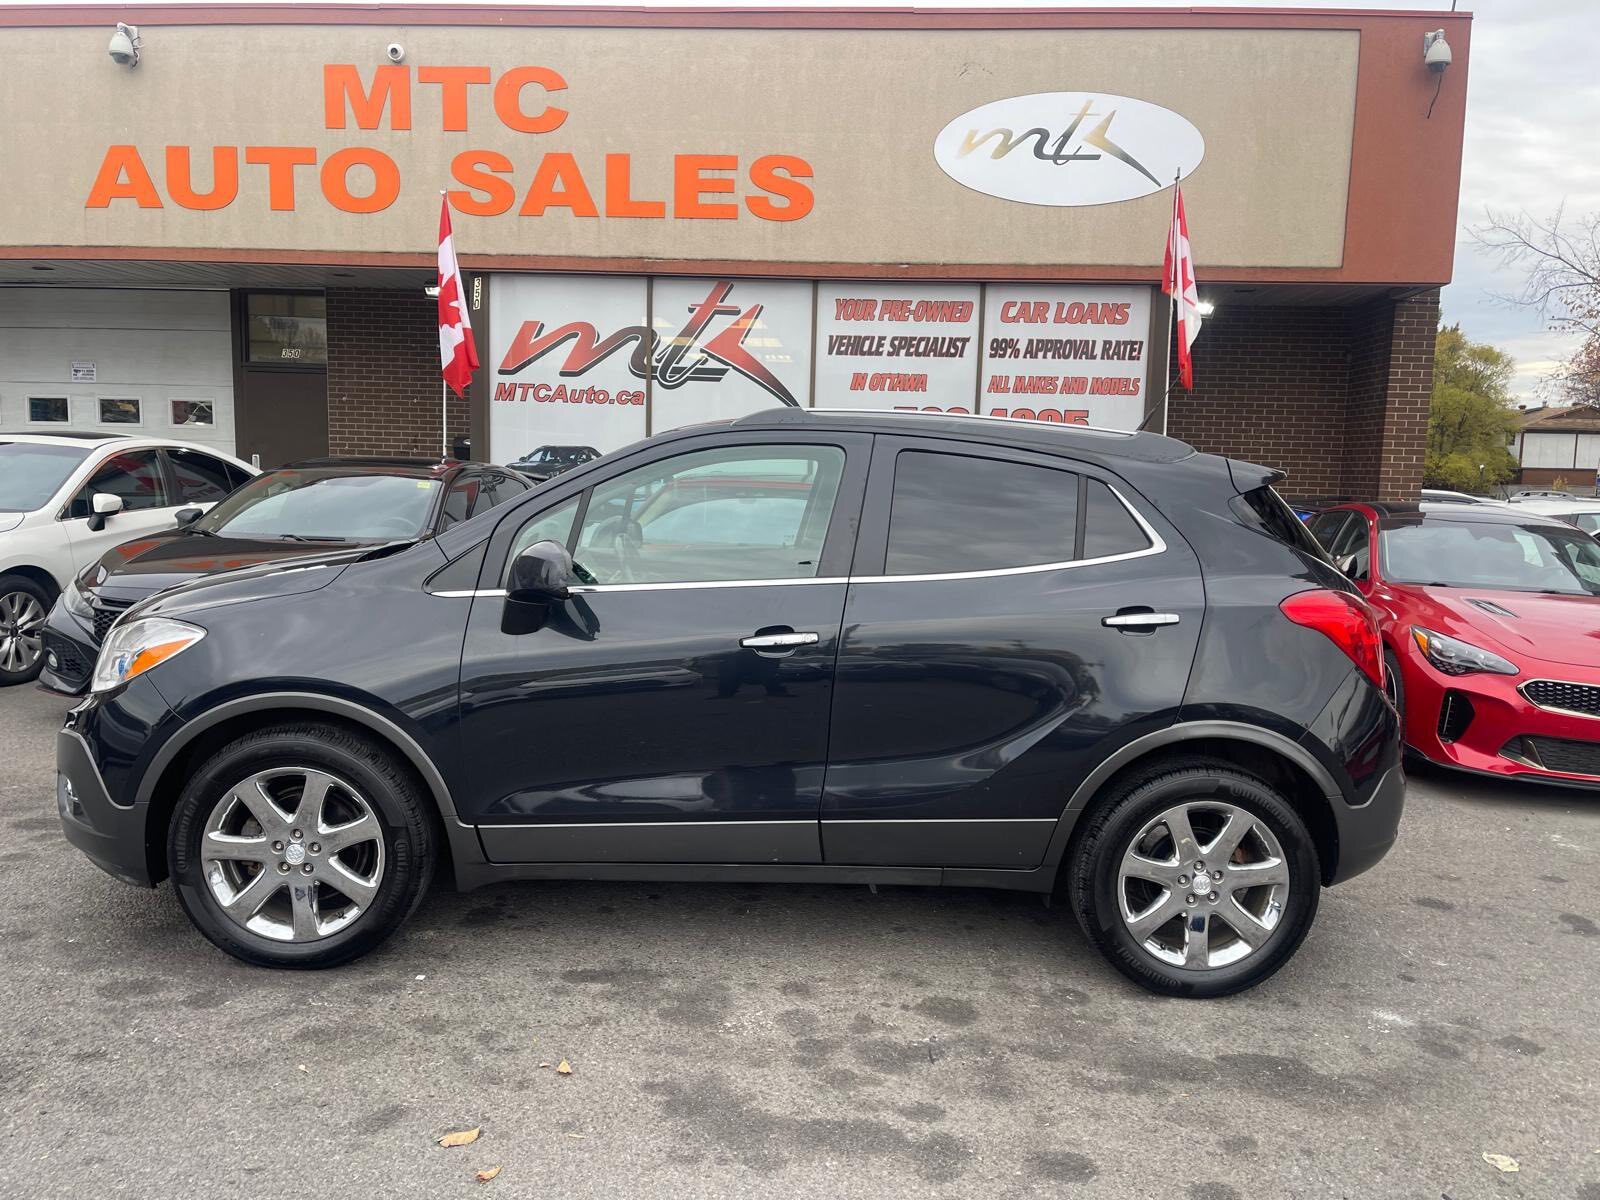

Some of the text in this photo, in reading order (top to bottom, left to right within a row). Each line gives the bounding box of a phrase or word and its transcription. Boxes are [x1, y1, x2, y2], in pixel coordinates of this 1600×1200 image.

[324, 64, 569, 134] MTC
[85, 145, 815, 222] AUTO SALES
[835, 299, 974, 322] YOUR PRE-OWNED
[1000, 301, 1131, 325] CAR LOANS
[828, 335, 971, 358] VEHICLE SPECIALIST
[989, 338, 1144, 361] 99% APPROVAL RATE!
[850, 372, 928, 392] IN OTTAWA
[987, 375, 1140, 395] ALL MAKES AND MODELS
[494, 383, 645, 405] MTCAuto.ca
